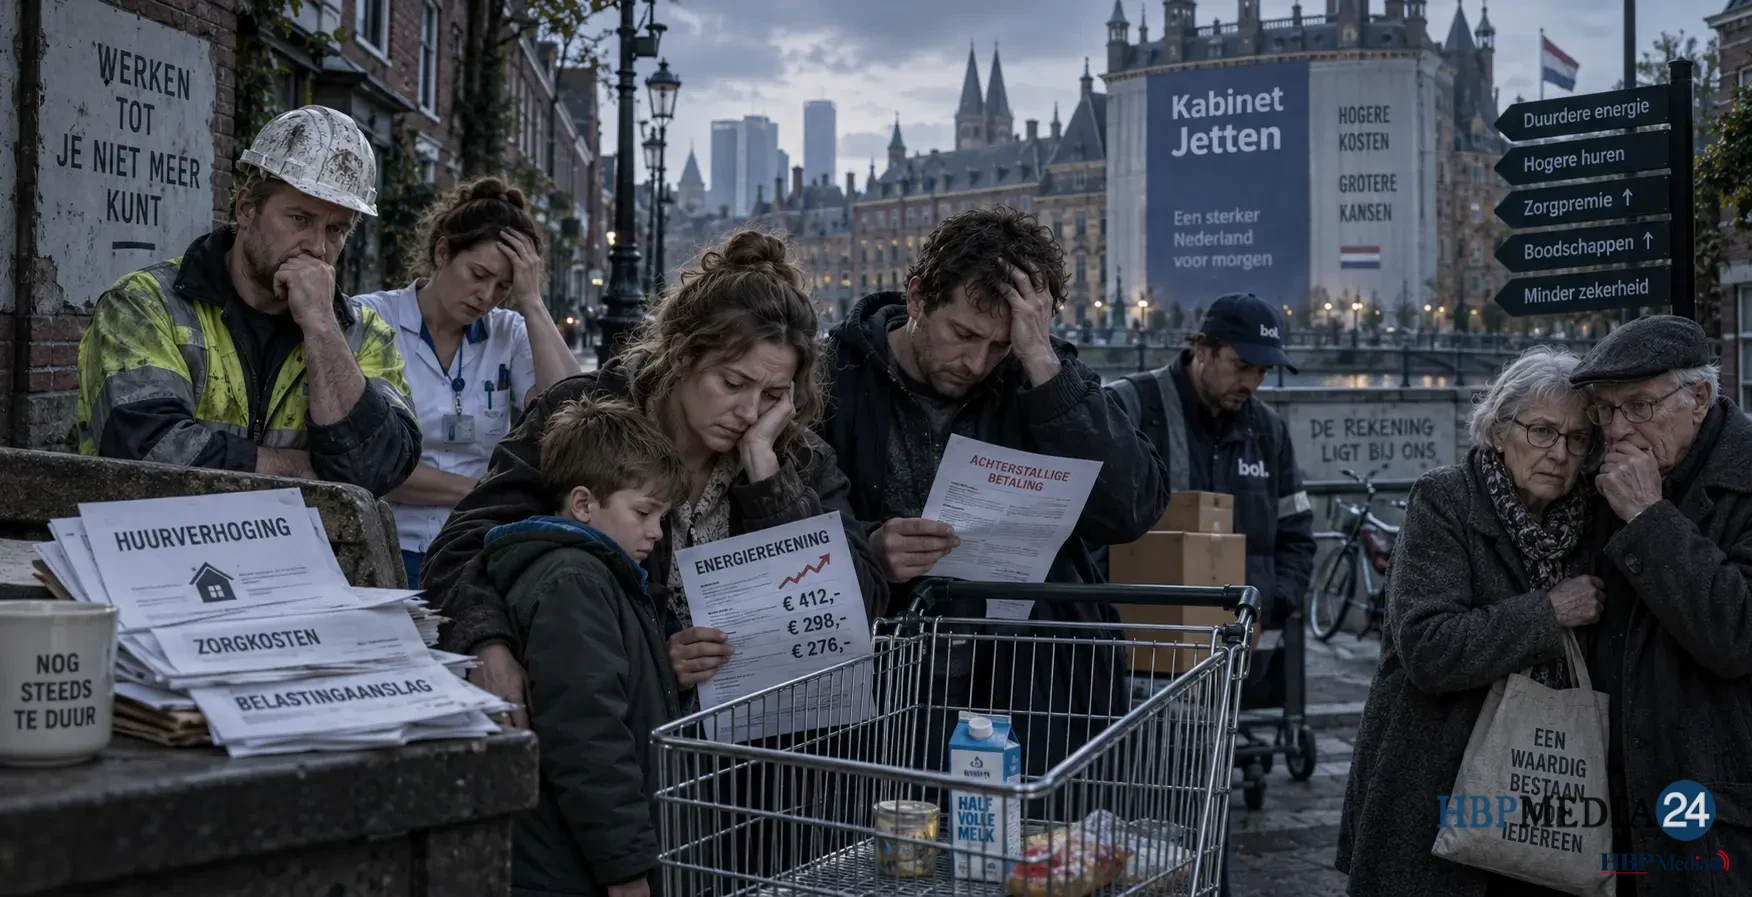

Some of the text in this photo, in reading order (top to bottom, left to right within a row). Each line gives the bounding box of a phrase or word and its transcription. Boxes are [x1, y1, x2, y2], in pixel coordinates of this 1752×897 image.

[98, 43, 190, 100] WERKEN
[1172, 87, 1284, 120] Kabinet
[1339, 105, 1391, 125] HOGERE
[1524, 98, 1650, 128] Duurdere energie
[116, 96, 155, 135] TOT
[1171, 125, 1281, 157] Jetten
[1339, 132, 1389, 152] KOSTEN
[57, 134, 200, 189] JE NIET MEER
[1524, 148, 1625, 174] Hogere huren
[1339, 174, 1397, 193] GROTERE
[107, 189, 162, 226] KUNT
[1340, 203, 1392, 223] KANSEN
[1524, 192, 1612, 217] Zorgpremie
[1174, 207, 1260, 226] Een sterker
[1174, 229, 1253, 248] Nederland
[1524, 236, 1634, 260] Boodschappen
[1173, 252, 1272, 271] voor morgen
[1524, 278, 1649, 304] Minder zekerheid
[1260, 324, 1280, 339] bol.
[1310, 418, 1434, 439] DE REKENING
[1322, 442, 1437, 463] LIGT BIJ ONS
[970, 454, 1070, 483] ACHTERSTALLIGE
[1238, 458, 1269, 477] bol.
[988, 472, 1044, 493] BETALING
[114, 517, 292, 552] HUURVERHOGING
[695, 530, 830, 575] ENERGIEREKENING
[783, 588, 840, 611] € 412,-
[788, 620, 799, 635] €
[803, 613, 846, 632] 298,-
[193, 628, 321, 655] ZORGKOSTEN
[792, 637, 851, 658] € 276,-
[36, 653, 79, 675] NOG
[21, 680, 92, 701] STEEDS
[235, 678, 433, 711] BELASTINGAANSLAG
[14, 706, 96, 730] TE DUUR
[1534, 728, 1566, 750] EEN
[1511, 748, 1586, 779] WAARDIG
[1510, 772, 1585, 803] BESTAAN
[958, 796, 992, 812] HALF
[958, 811, 995, 827] VOLLE
[958, 826, 995, 843] MELK
[1502, 822, 1583, 853] IEDEREEN
